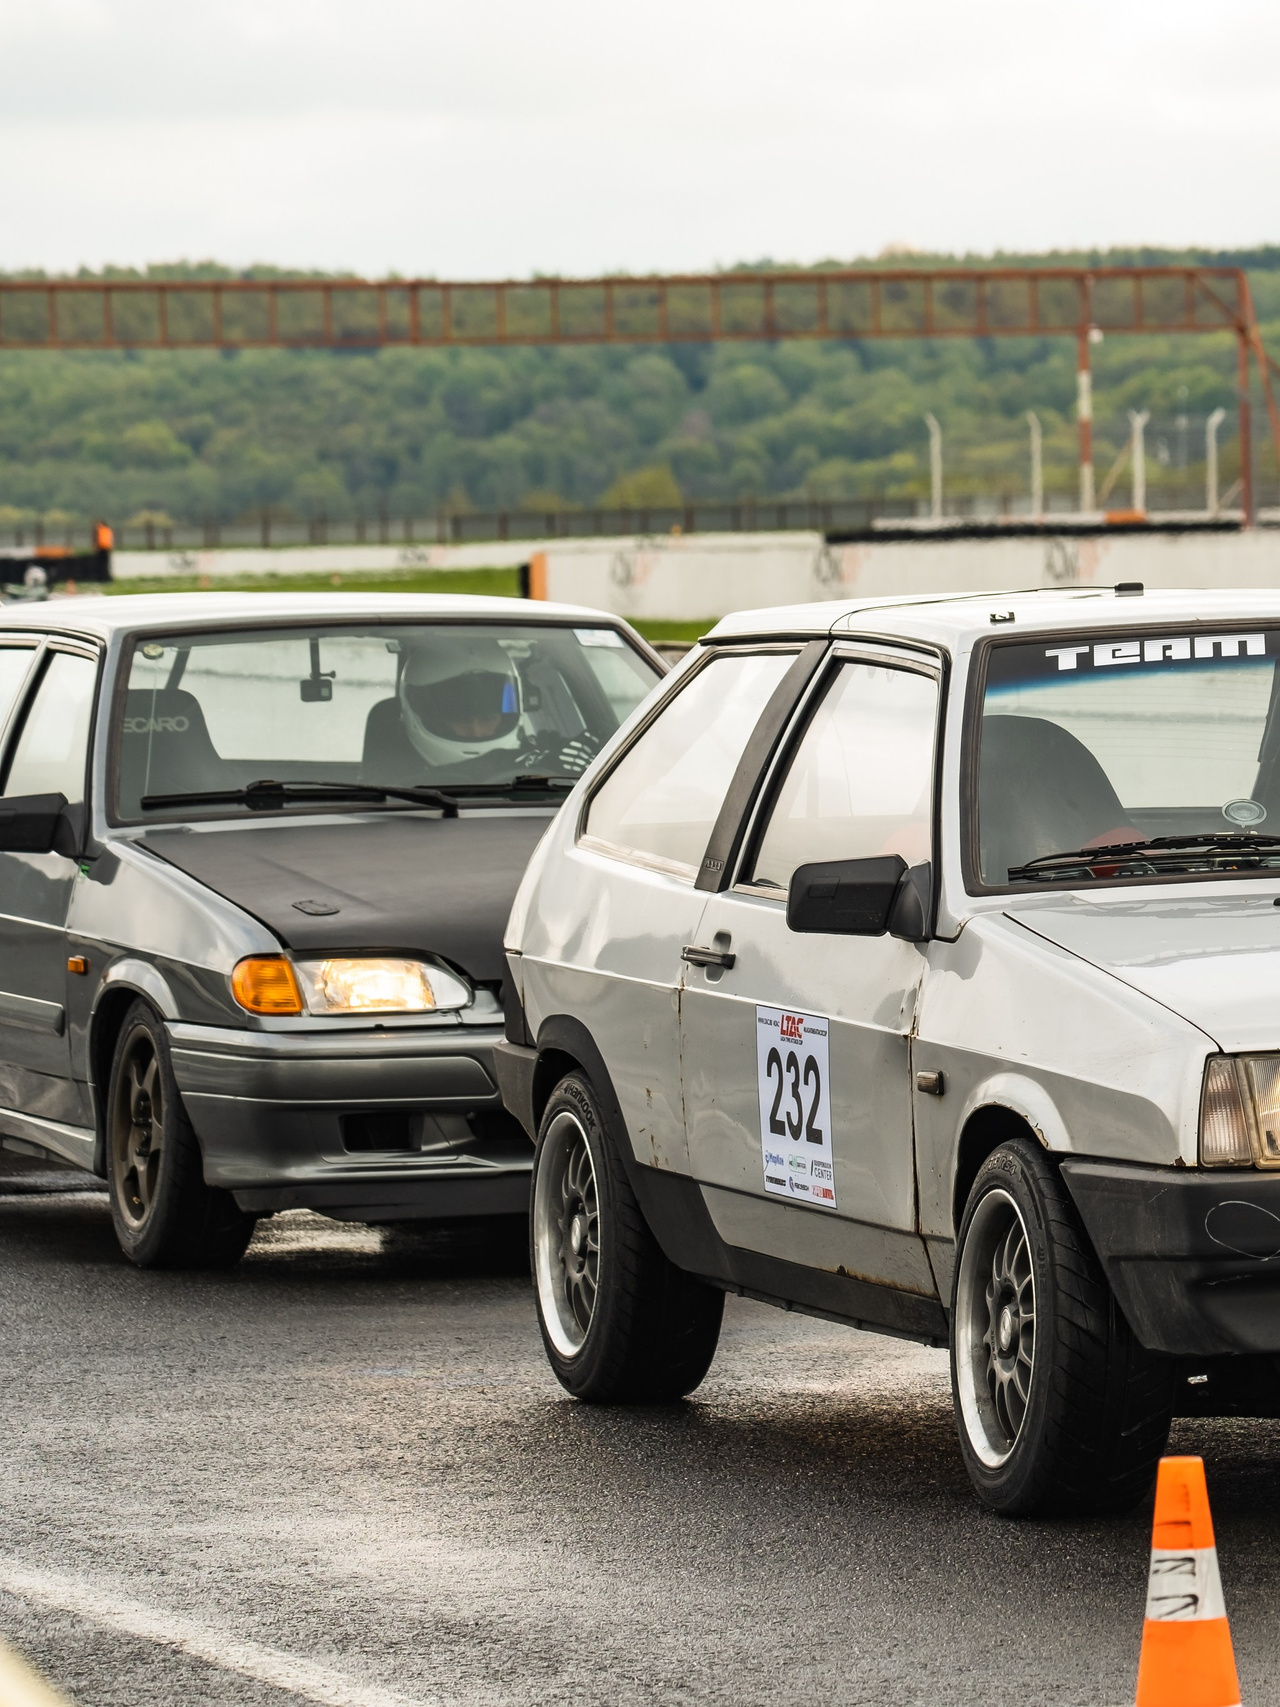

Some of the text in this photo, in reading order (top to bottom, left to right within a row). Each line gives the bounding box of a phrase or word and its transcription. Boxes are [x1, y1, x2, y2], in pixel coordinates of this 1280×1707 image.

[1045, 633, 1265, 671] TEAM
[123, 715, 190, 733] ECARO
[766, 1047, 823, 1145] 232
